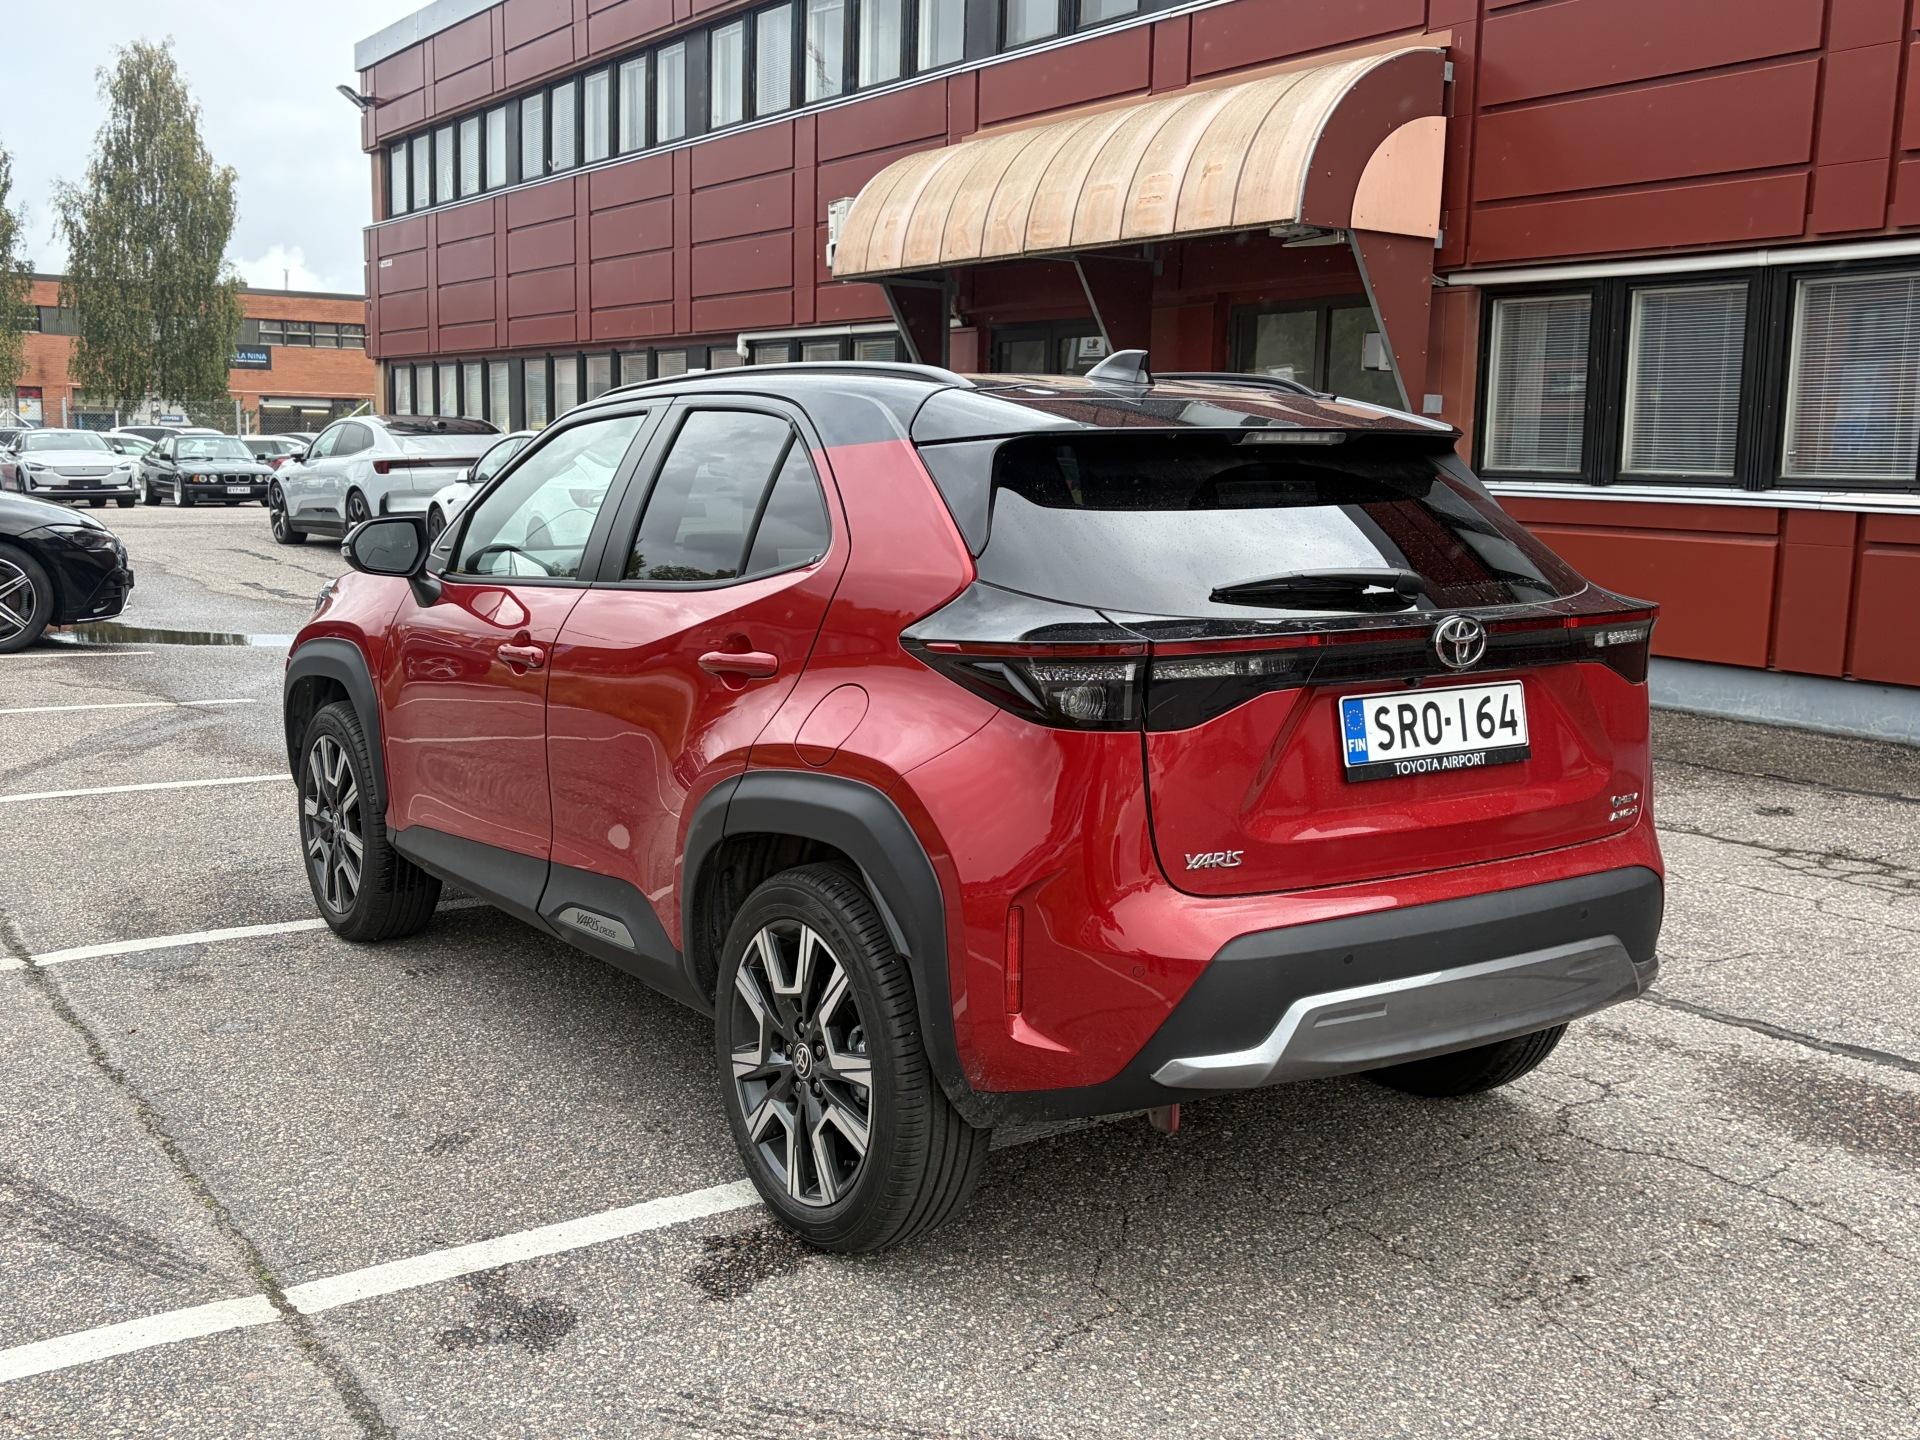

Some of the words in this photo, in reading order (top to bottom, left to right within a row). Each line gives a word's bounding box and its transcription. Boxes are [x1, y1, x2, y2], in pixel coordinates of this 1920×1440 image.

[247, 352, 267, 360] NINA
[1374, 693, 1518, 751] SRO-164
[1347, 738, 1367, 752] FIN
[1394, 758, 1440, 775] TOYOTA
[1441, 752, 1486, 770] AIRPORT
[600, 925, 617, 939] CROSS
